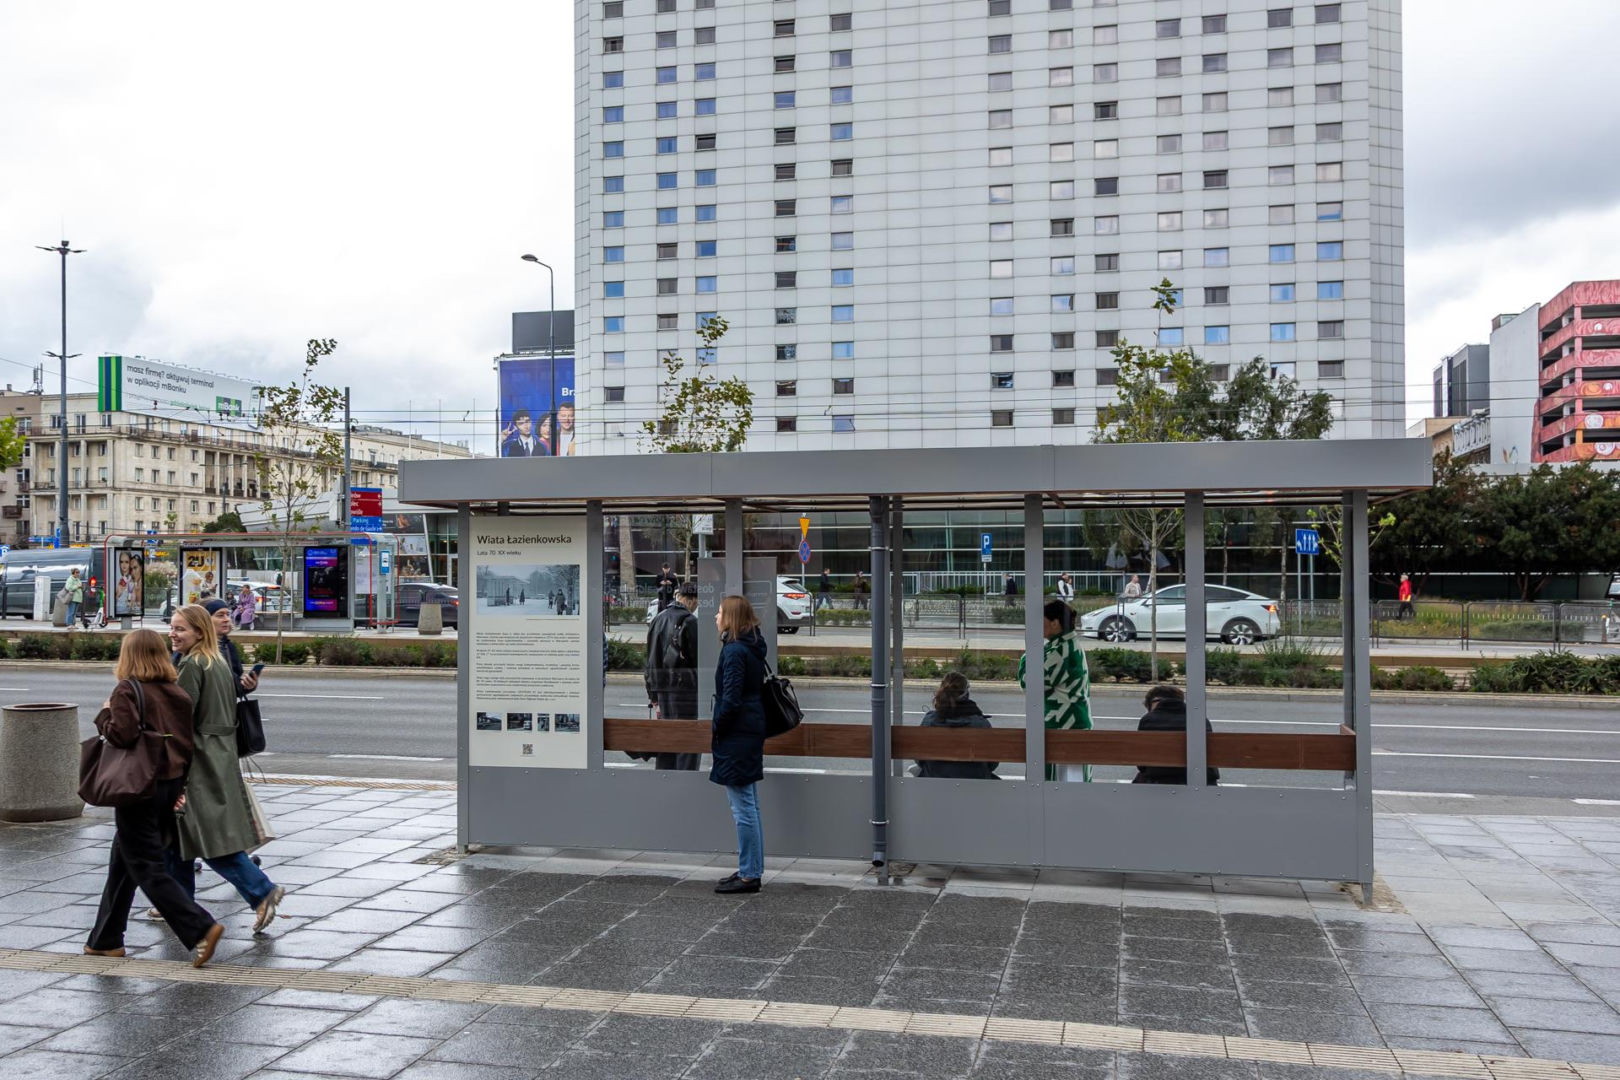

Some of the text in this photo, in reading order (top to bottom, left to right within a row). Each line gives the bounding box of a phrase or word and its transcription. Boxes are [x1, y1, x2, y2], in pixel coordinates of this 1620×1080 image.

[127, 364, 215, 389] masz firmę? aktywuj terminal
[134, 376, 161, 390] aplikacji
[161, 383, 187, 394] mBanku
[477, 534, 572, 545] Wiata Łazienkowska
[983, 535, 990, 549] P
